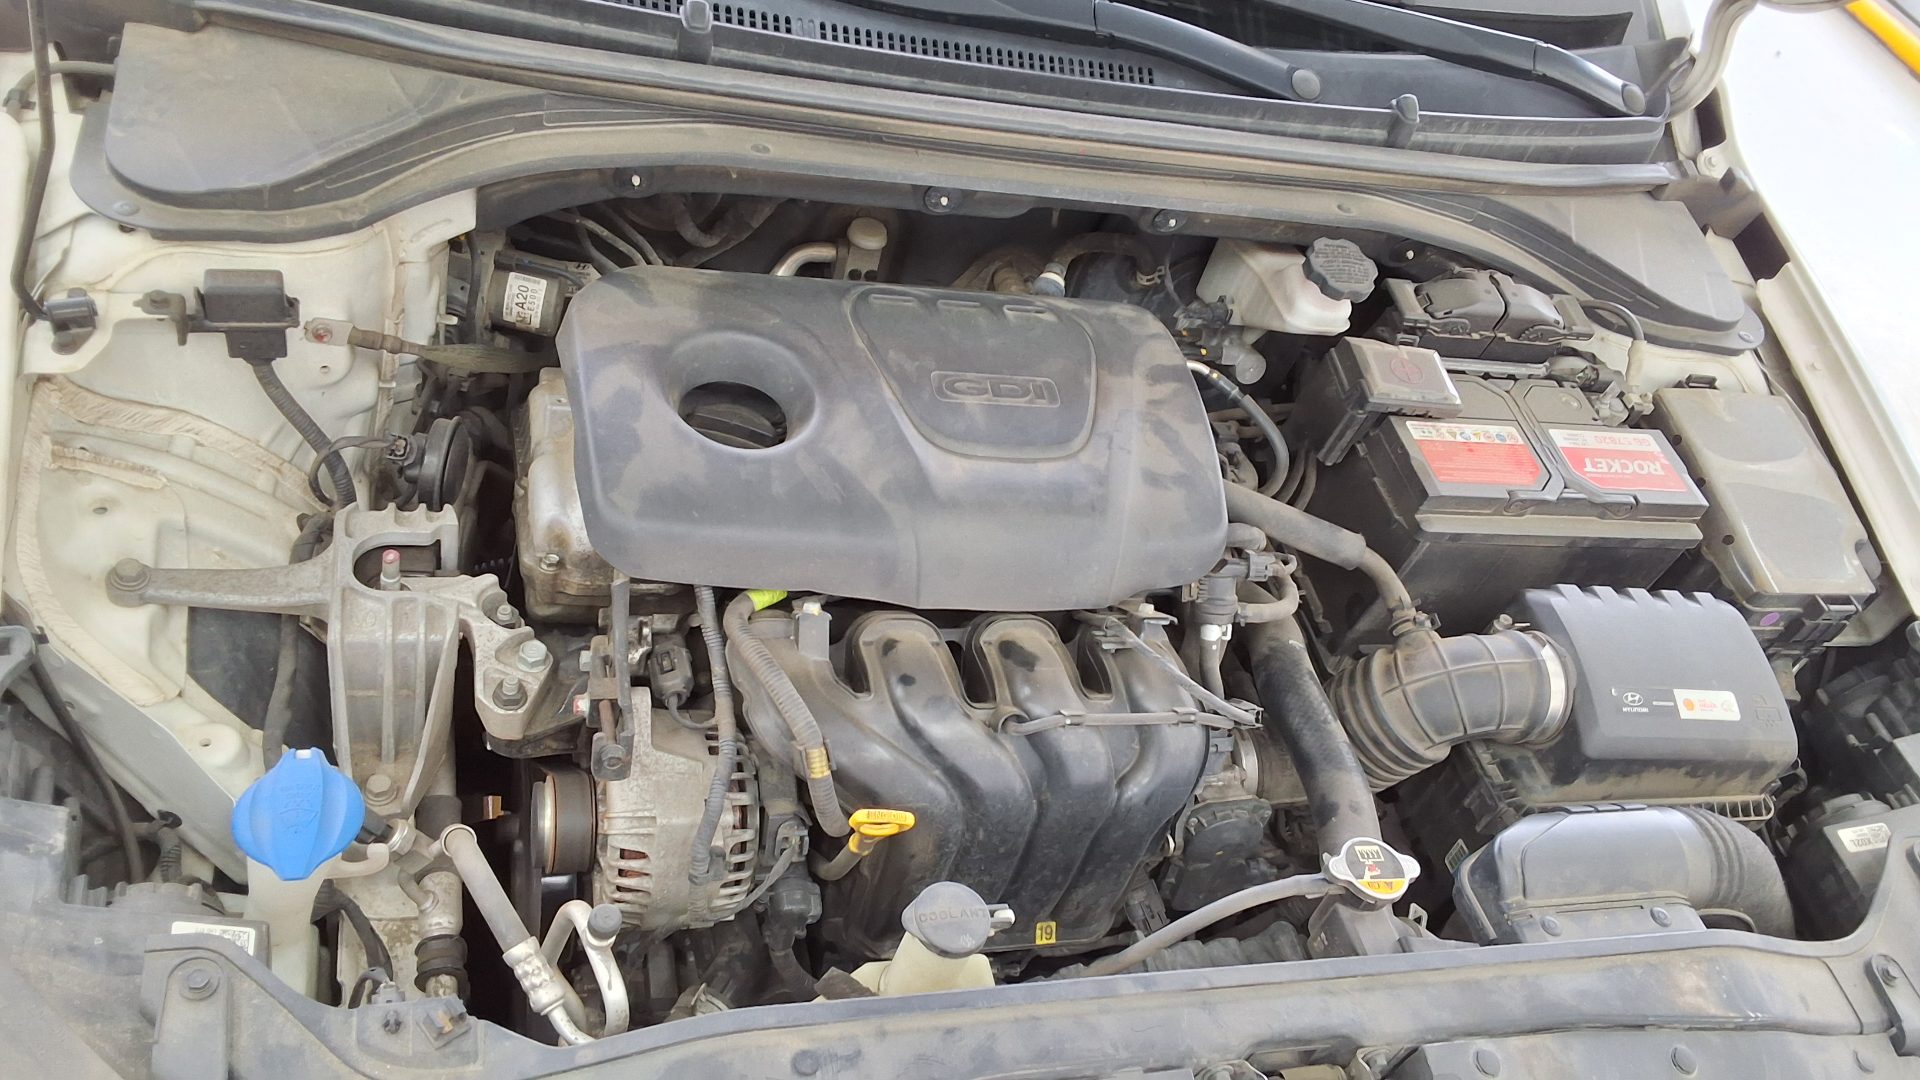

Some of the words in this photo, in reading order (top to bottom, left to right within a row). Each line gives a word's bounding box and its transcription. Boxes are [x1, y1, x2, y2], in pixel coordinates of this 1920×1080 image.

[515, 284, 530, 310] A20
[943, 376, 1047, 401] GDI
[1583, 456, 1665, 475] ROCKET
[918, 907, 988, 923] COOLANT
[1039, 924, 1054, 942] 19
